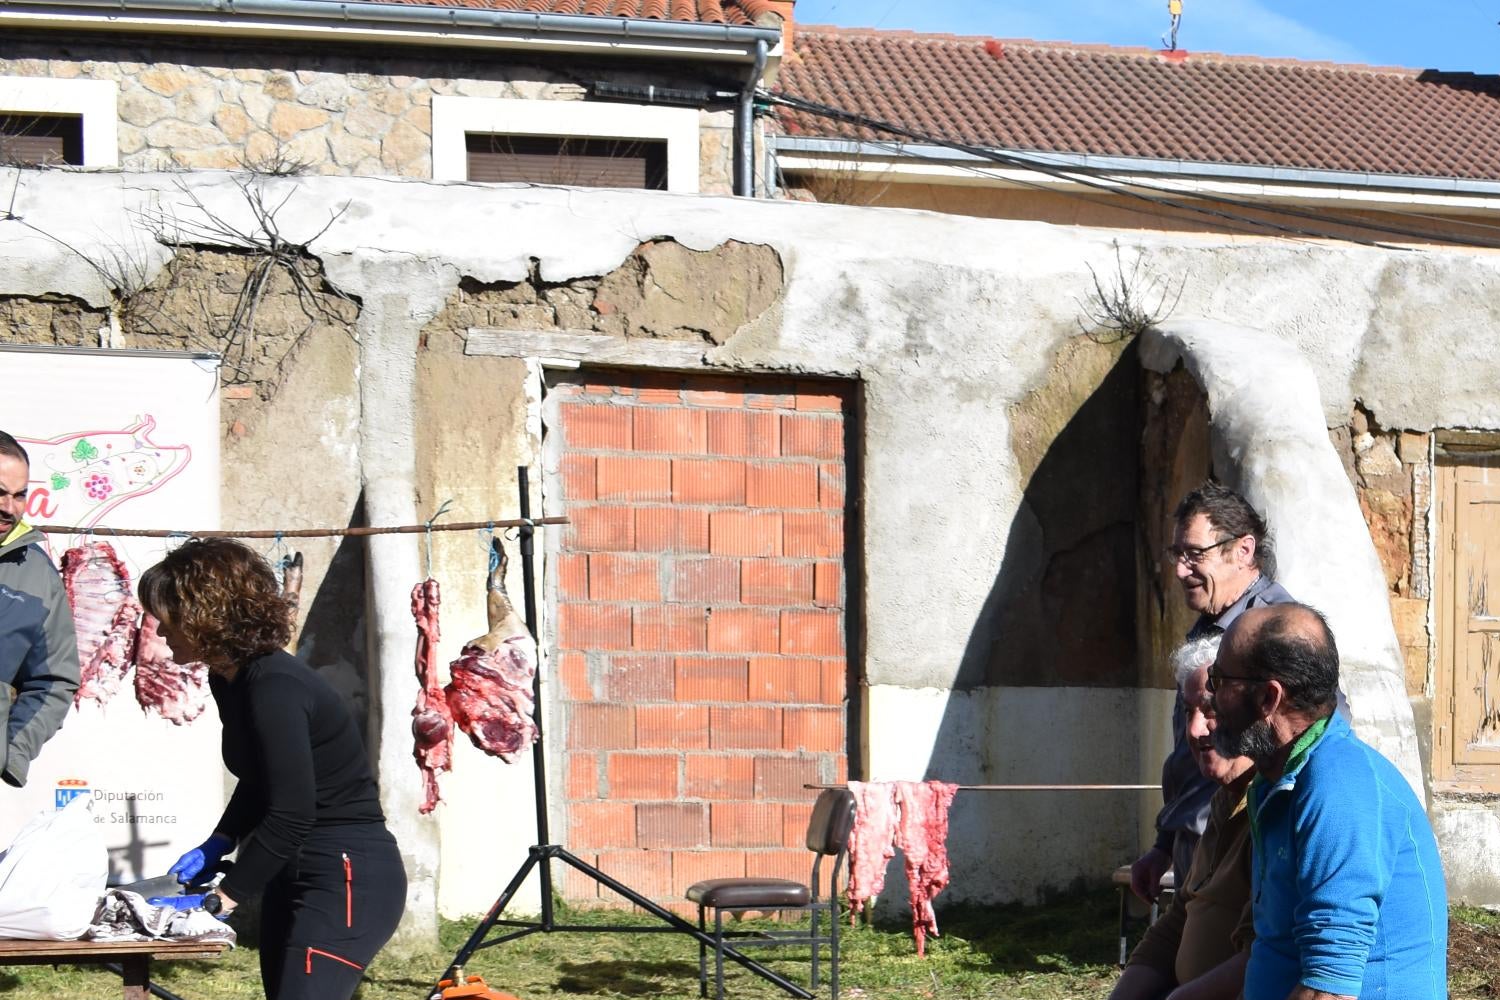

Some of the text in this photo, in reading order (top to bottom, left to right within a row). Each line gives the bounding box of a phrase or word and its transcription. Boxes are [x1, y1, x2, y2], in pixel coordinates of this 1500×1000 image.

[94, 789, 164, 803] Diputación
[93, 812, 177, 824] de Salamanca
